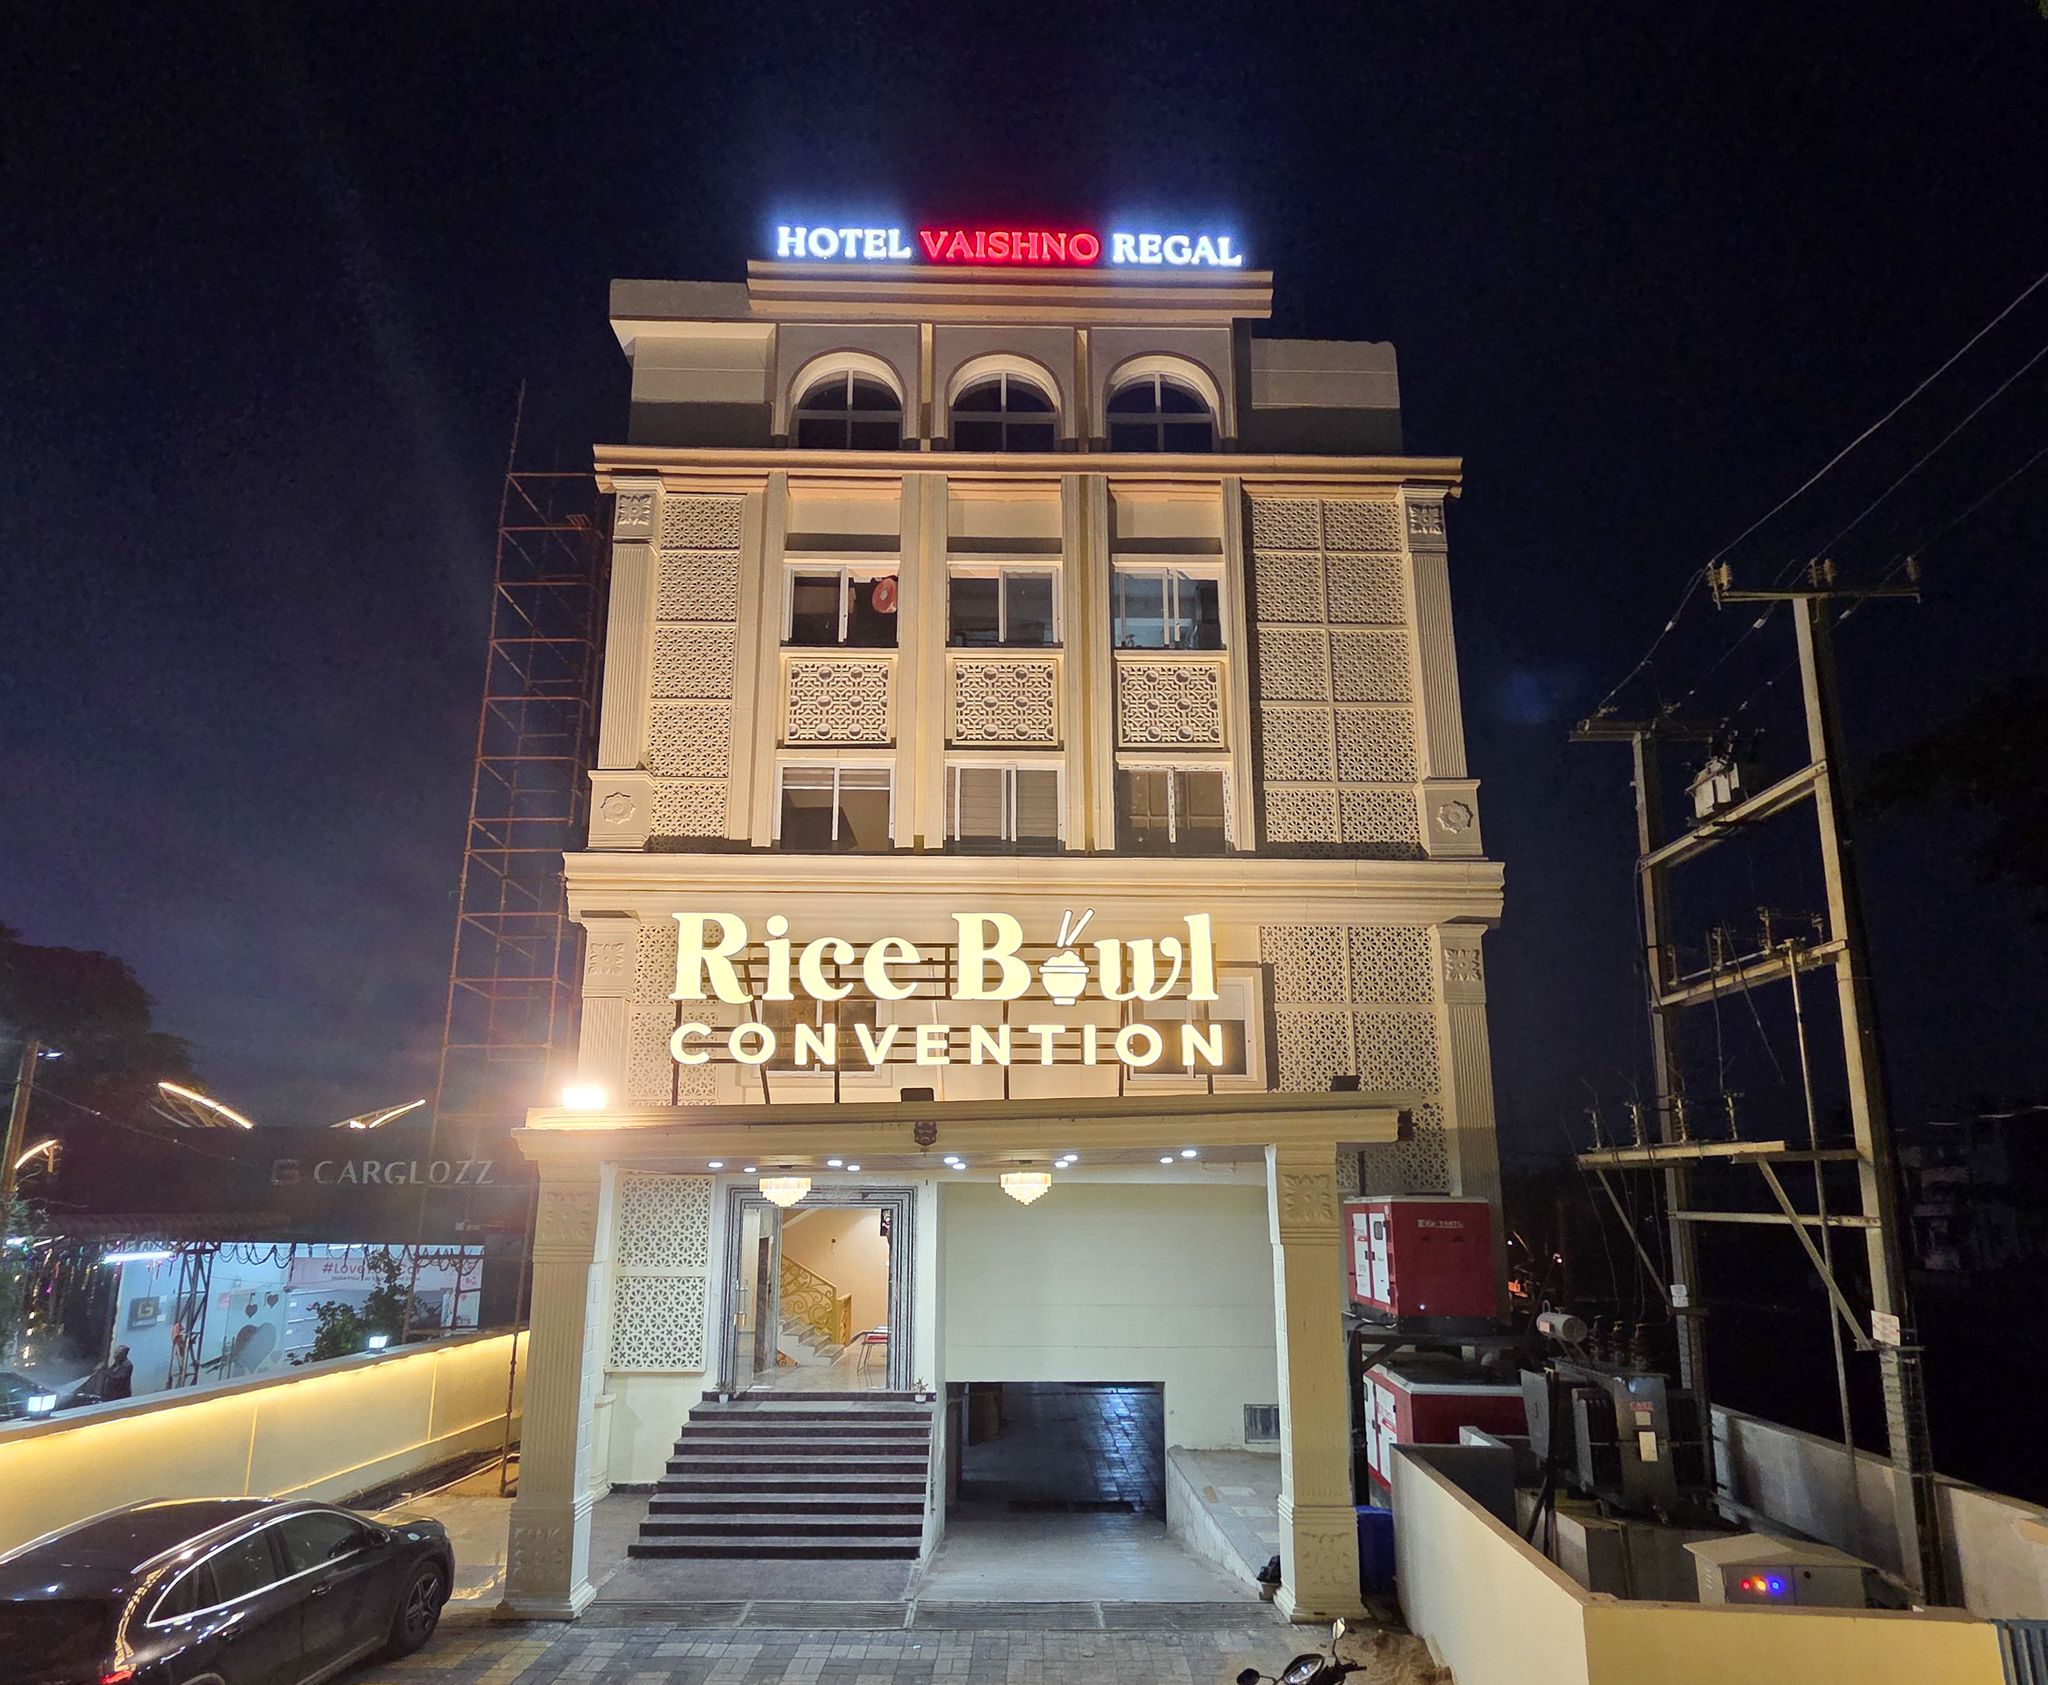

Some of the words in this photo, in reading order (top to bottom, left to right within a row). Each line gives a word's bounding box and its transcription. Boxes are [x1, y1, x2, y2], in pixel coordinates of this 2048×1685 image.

[776, 226, 912, 258] HOTEL
[920, 231, 1100, 262] VAISHNO
[1112, 233, 1242, 266] REGAL
[669, 912, 921, 1004] Rice
[669, 1022, 1224, 1067] CONVENTION
[313, 1160, 493, 1185] CARGLOZZ
